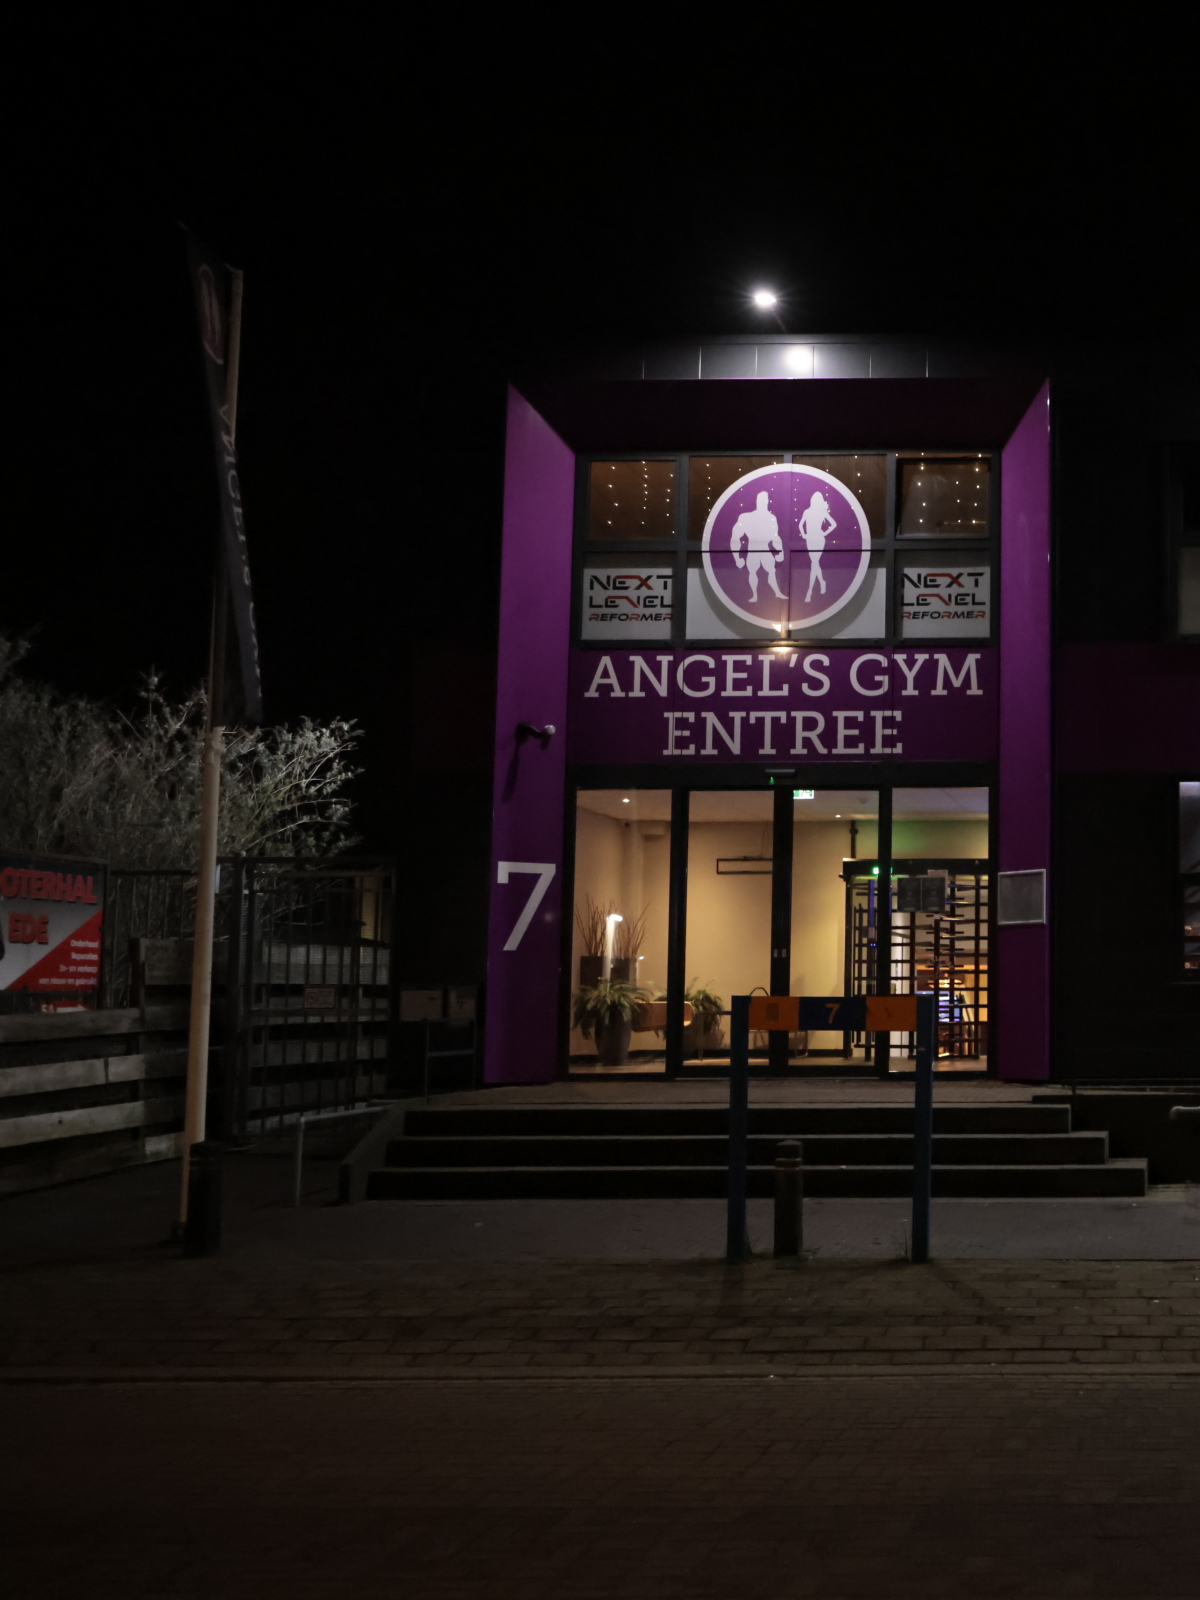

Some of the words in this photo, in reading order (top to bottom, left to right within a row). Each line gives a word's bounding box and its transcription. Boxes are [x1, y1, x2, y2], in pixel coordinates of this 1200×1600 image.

[590, 575, 674, 591] NEXT
[901, 572, 985, 588] NEXT
[589, 596, 674, 608] LEVEL
[901, 593, 986, 606] LEVEL
[589, 613, 674, 622] REFORMER
[901, 610, 986, 620] REFORMER
[584, 653, 831, 698] ANGEL'S
[849, 653, 983, 697] GYM
[662, 710, 904, 756] ENTREE
[497, 860, 557, 952] 7
[9, 912, 49, 944] EDE
[825, 1003, 841, 1024] 7
